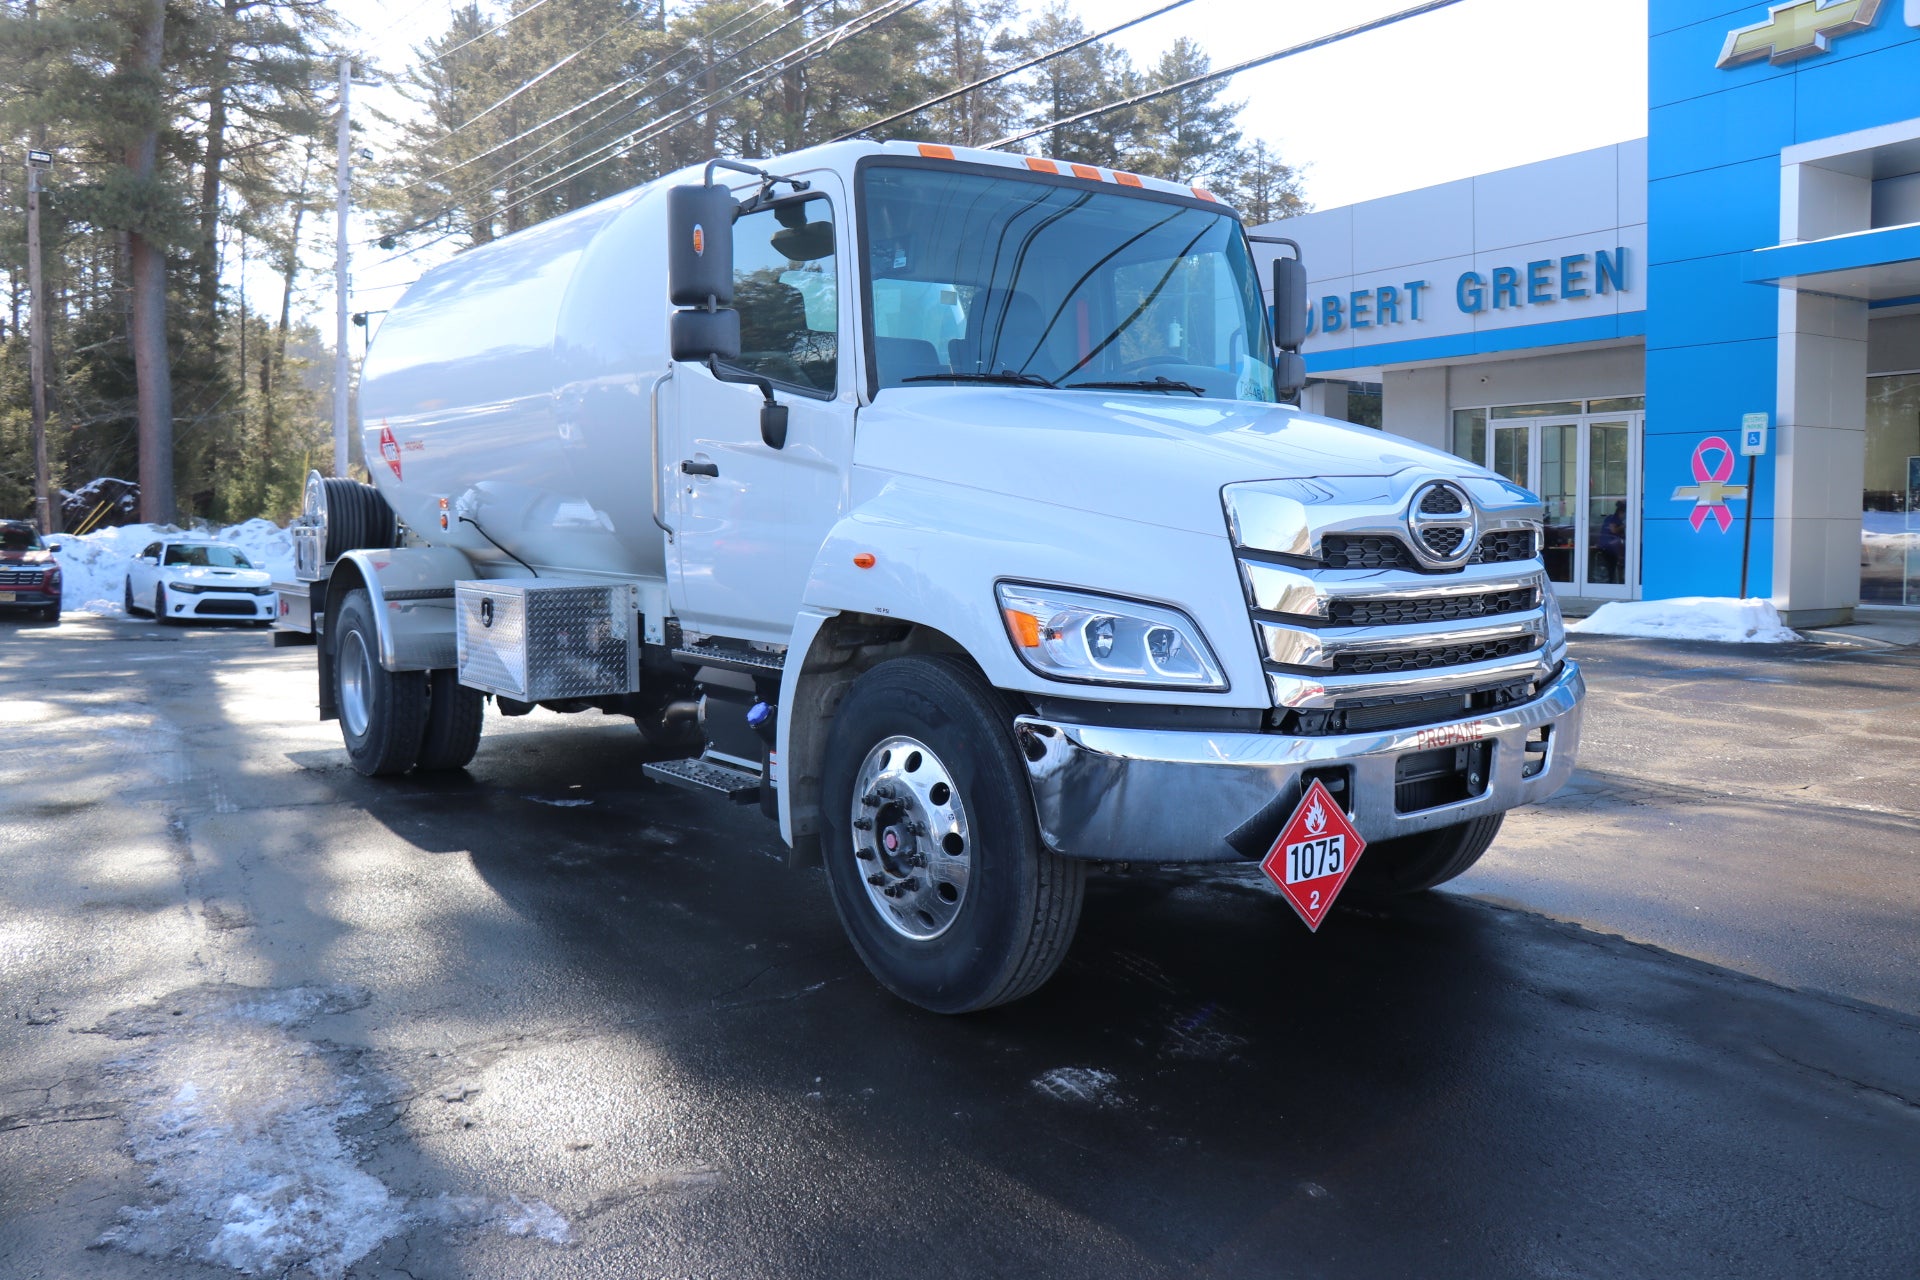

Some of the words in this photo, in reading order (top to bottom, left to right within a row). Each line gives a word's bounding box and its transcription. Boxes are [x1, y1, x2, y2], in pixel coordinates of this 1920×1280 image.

[1269, 279, 1428, 336] BERT
[1455, 246, 1629, 314] GREEN
[1416, 720, 1483, 750] PROPANE
[1291, 837, 1341, 880] 1075
[1309, 890, 1320, 910] 2
